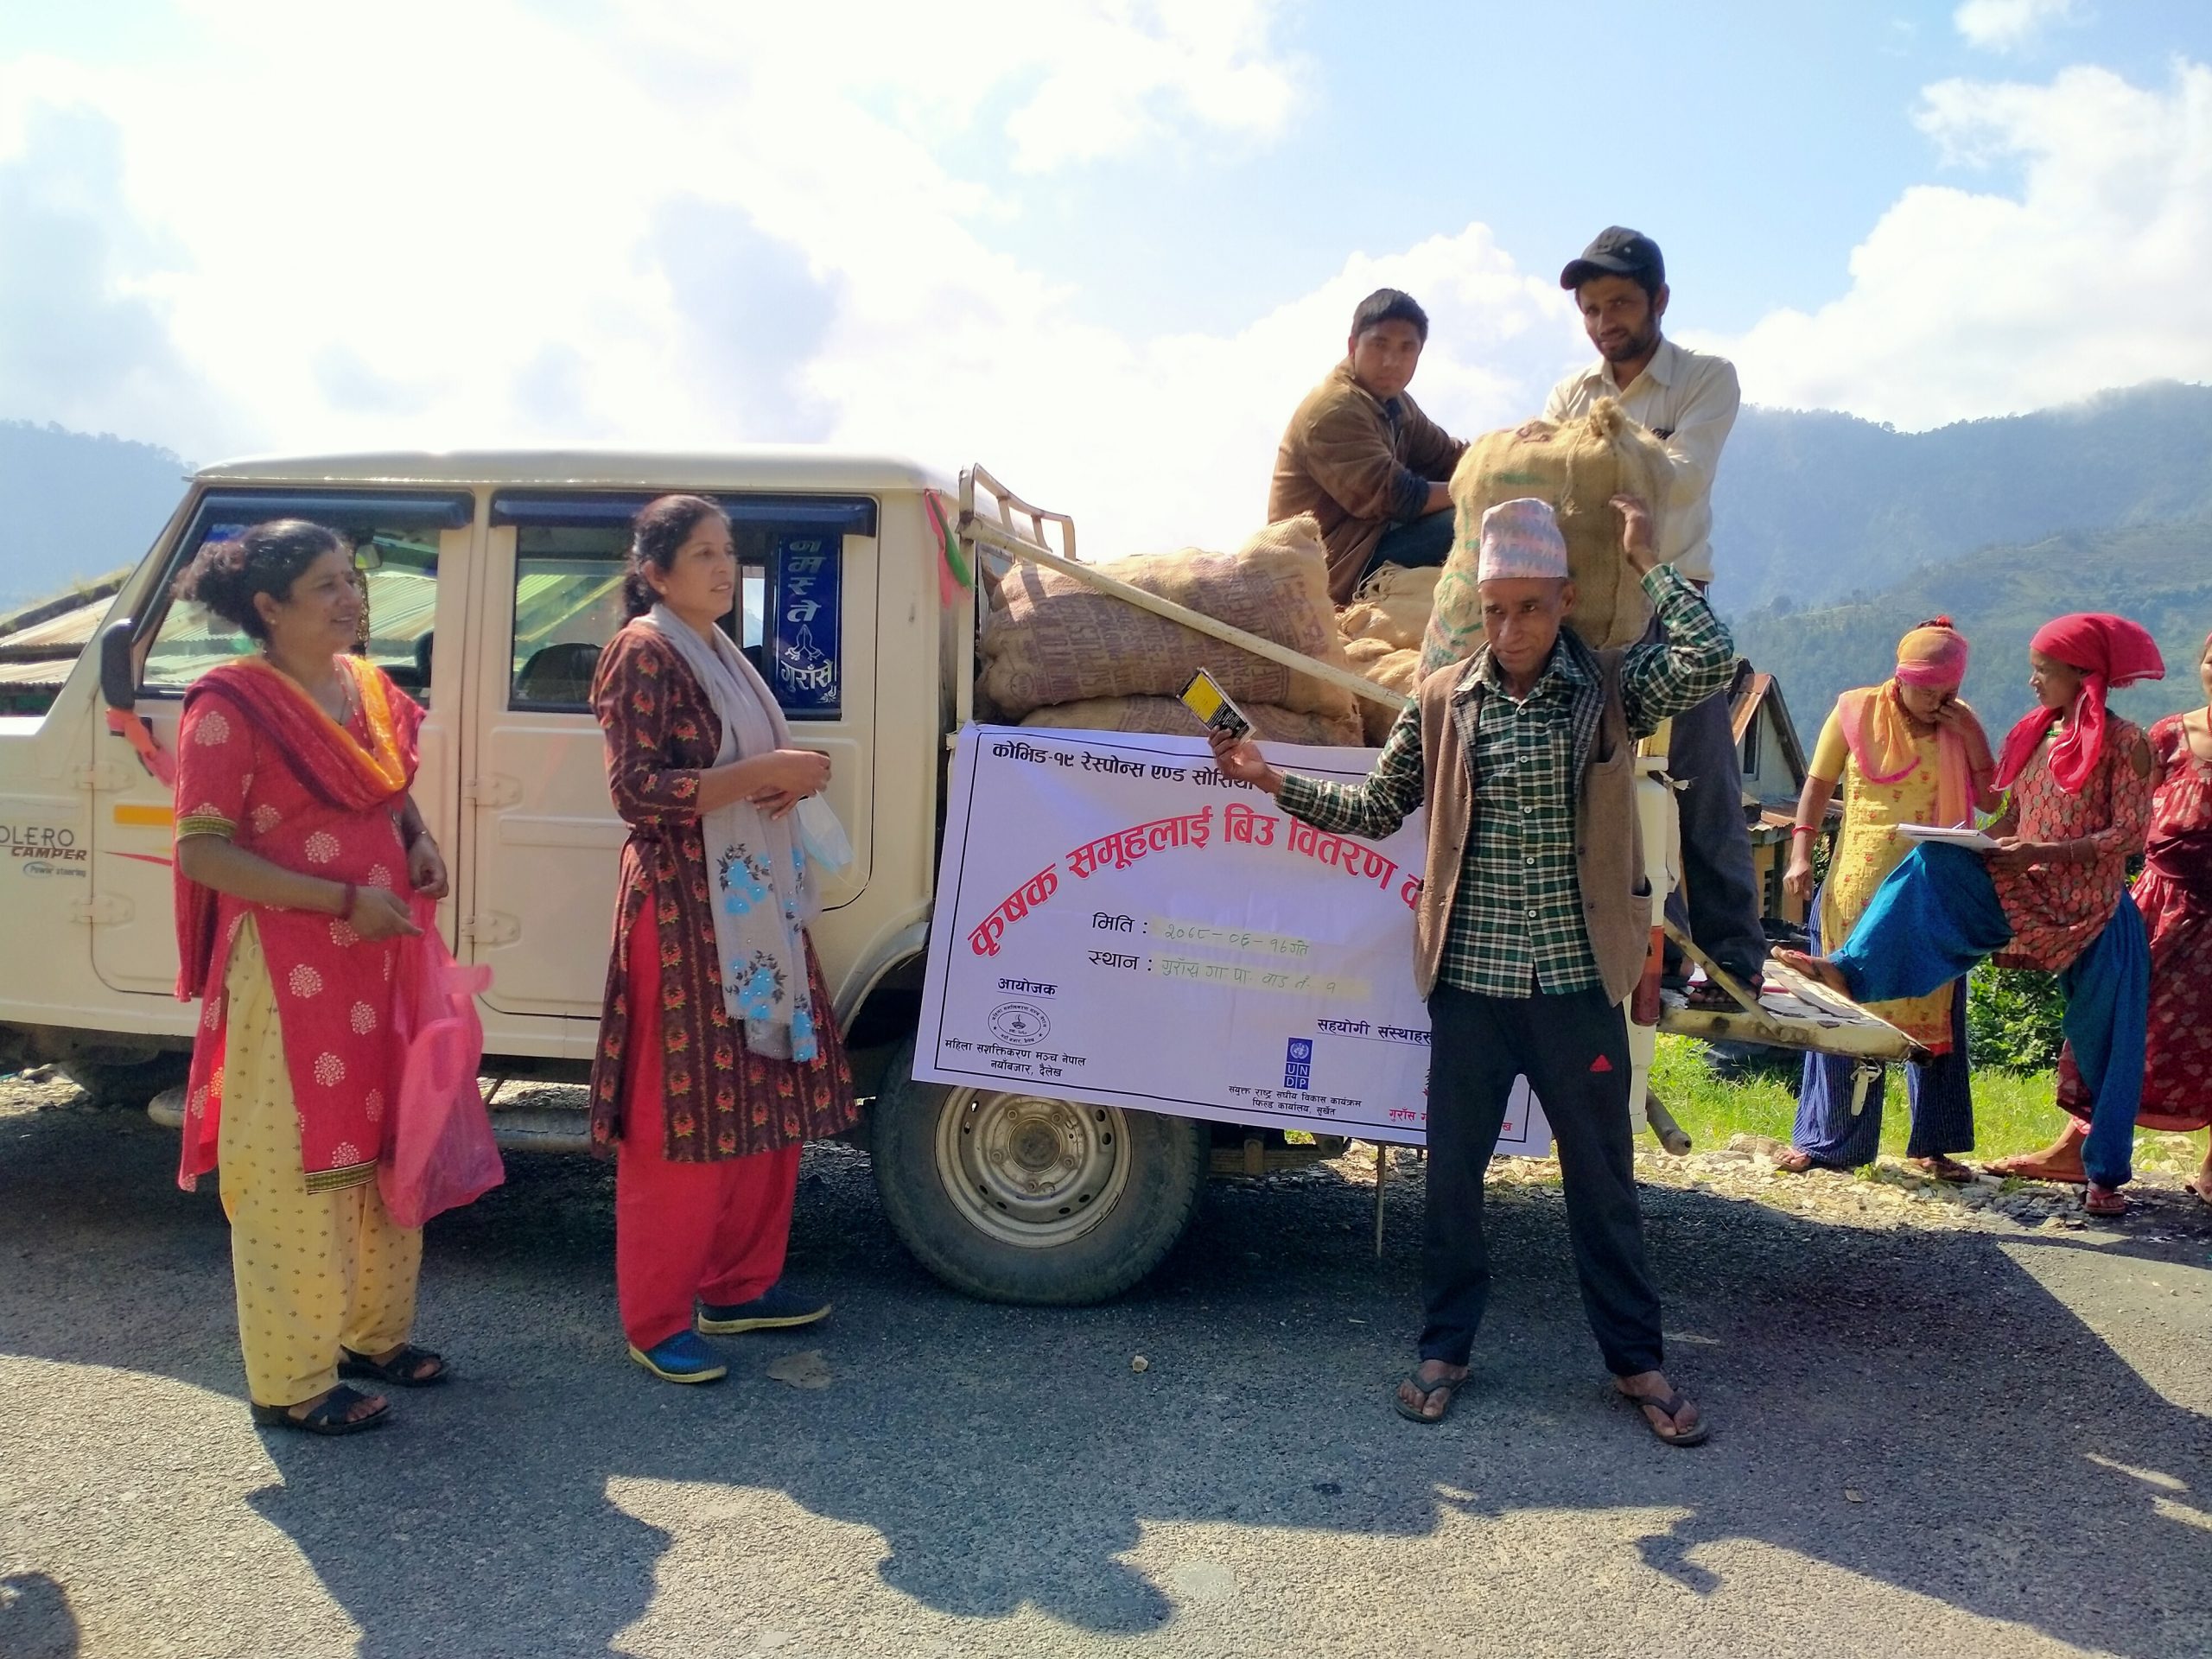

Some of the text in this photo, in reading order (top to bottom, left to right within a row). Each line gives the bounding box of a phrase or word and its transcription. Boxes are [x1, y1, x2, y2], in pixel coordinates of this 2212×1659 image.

[993, 741, 1074, 767] कोभिड-१९
[1081, 751, 1146, 778] रेस्पोन्स
[1151, 765, 1187, 782] एण्ड
[0, 825, 74, 849] OLERO
[11, 846, 87, 861] CAMPER
[967, 862, 1058, 957] कृषक
[1065, 804, 1214, 880] समूहलाई
[1224, 803, 1280, 847] बिउ
[1287, 817, 1399, 891] वितरण
[1092, 912, 1135, 933] मिति
[1088, 950, 1140, 970] स्थान
[997, 977, 1058, 995] आयोजक
[1317, 1019, 1370, 1035] सहयोगी
[945, 1038, 973, 1051] महिला
[977, 1043, 1032, 1058] सशक्तिकरण
[1062, 1052, 1086, 1066] नेपाल
[1039, 1062, 1063, 1077] दैलेख
[1301, 1092, 1326, 1104] विकास
[1389, 1107, 1416, 1122] गुराँस
